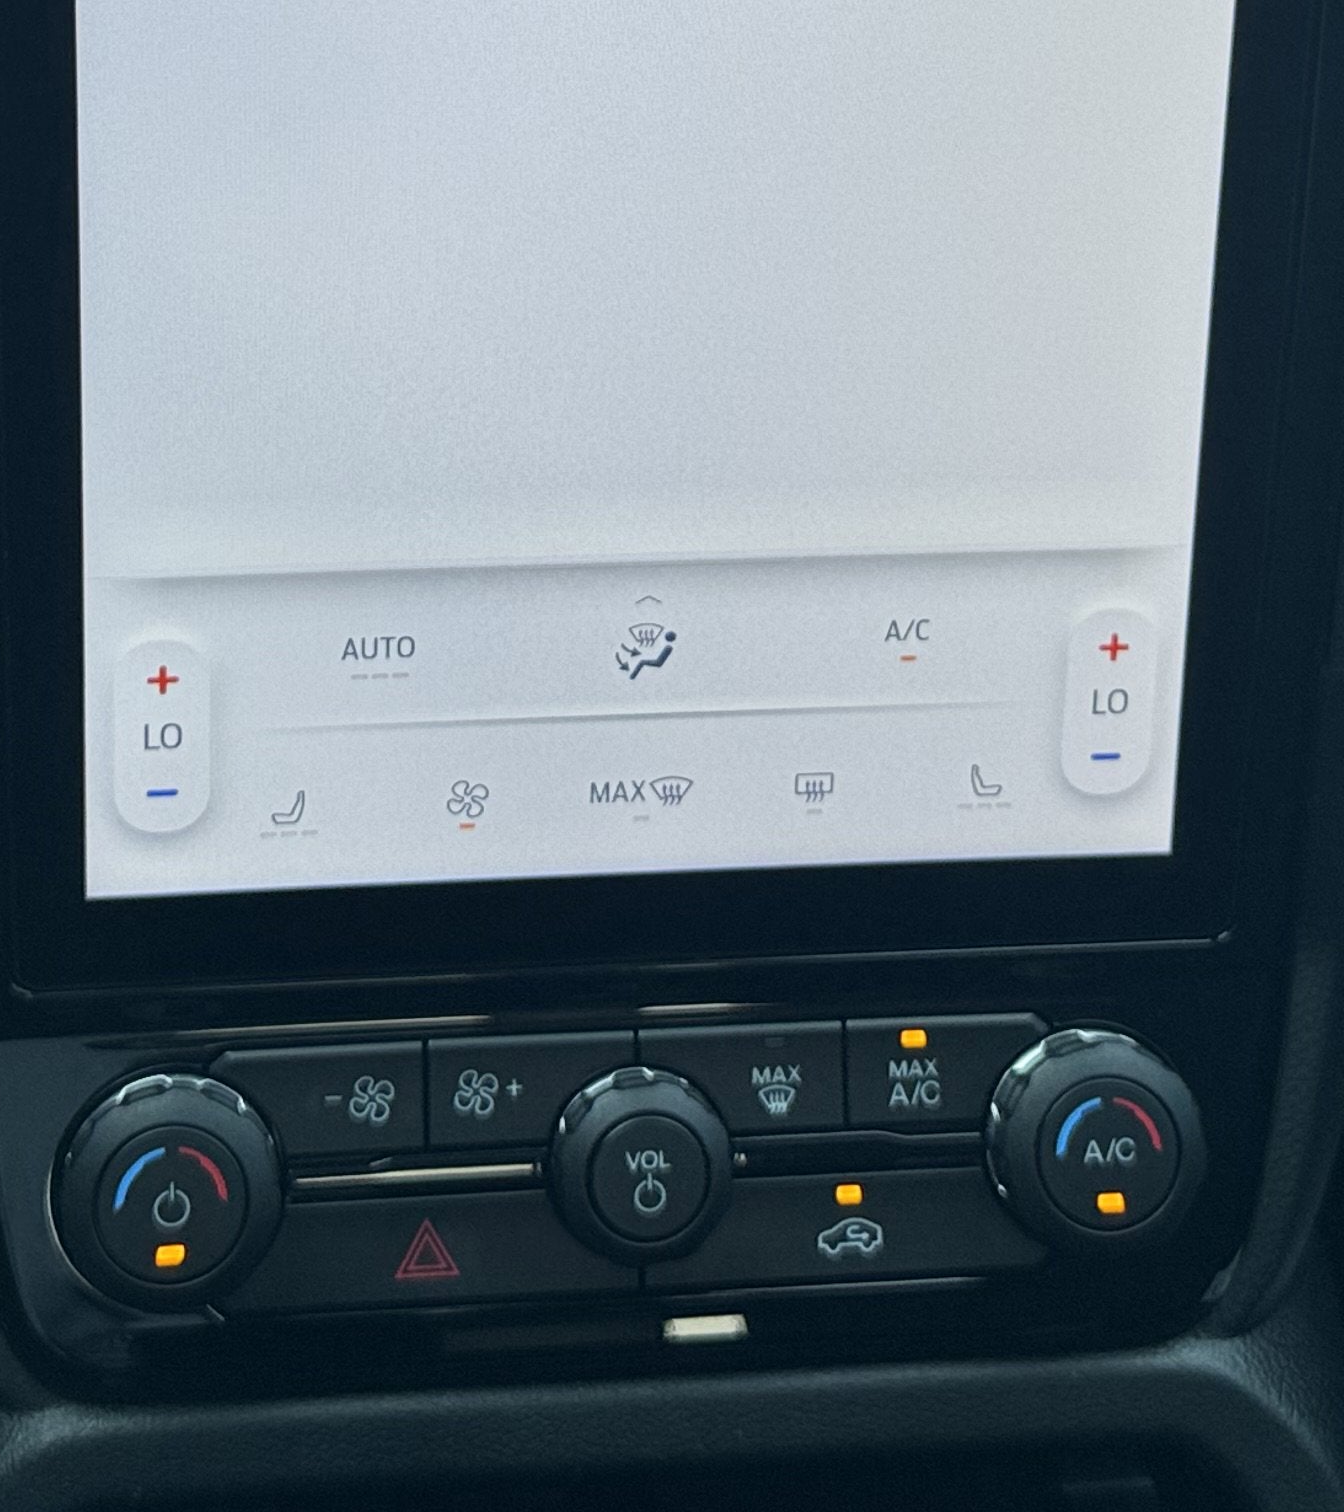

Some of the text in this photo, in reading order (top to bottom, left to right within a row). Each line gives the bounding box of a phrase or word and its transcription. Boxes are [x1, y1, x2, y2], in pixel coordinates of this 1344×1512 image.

[884, 618, 930, 642] A/C
[341, 635, 416, 661] AUTO
[1091, 688, 1129, 716] LO
[143, 722, 183, 751] LO
[589, 780, 646, 804] MAX
[751, 1065, 802, 1085] MAX
[888, 1058, 939, 1079] MAX
[889, 1080, 940, 1107] A/C
[625, 1150, 671, 1171] VOL
[1083, 1137, 1135, 1164] A/C
